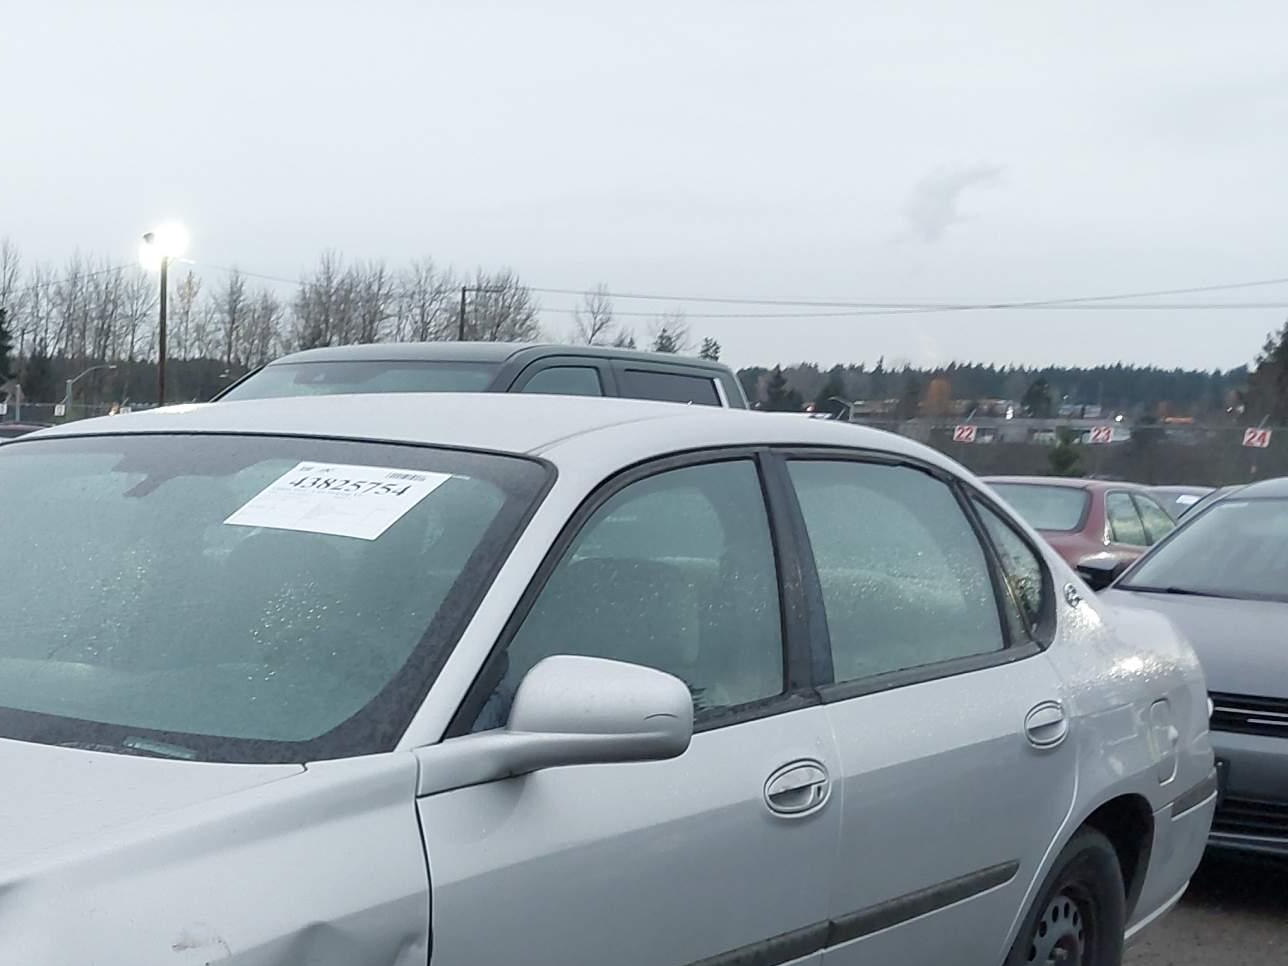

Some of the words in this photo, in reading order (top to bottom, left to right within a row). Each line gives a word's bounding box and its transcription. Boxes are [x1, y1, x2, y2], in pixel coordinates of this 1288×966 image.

[955, 426, 974, 441] 22
[1092, 427, 1112, 441] 23
[1245, 430, 1268, 445] 24
[289, 475, 413, 497] 43825754
